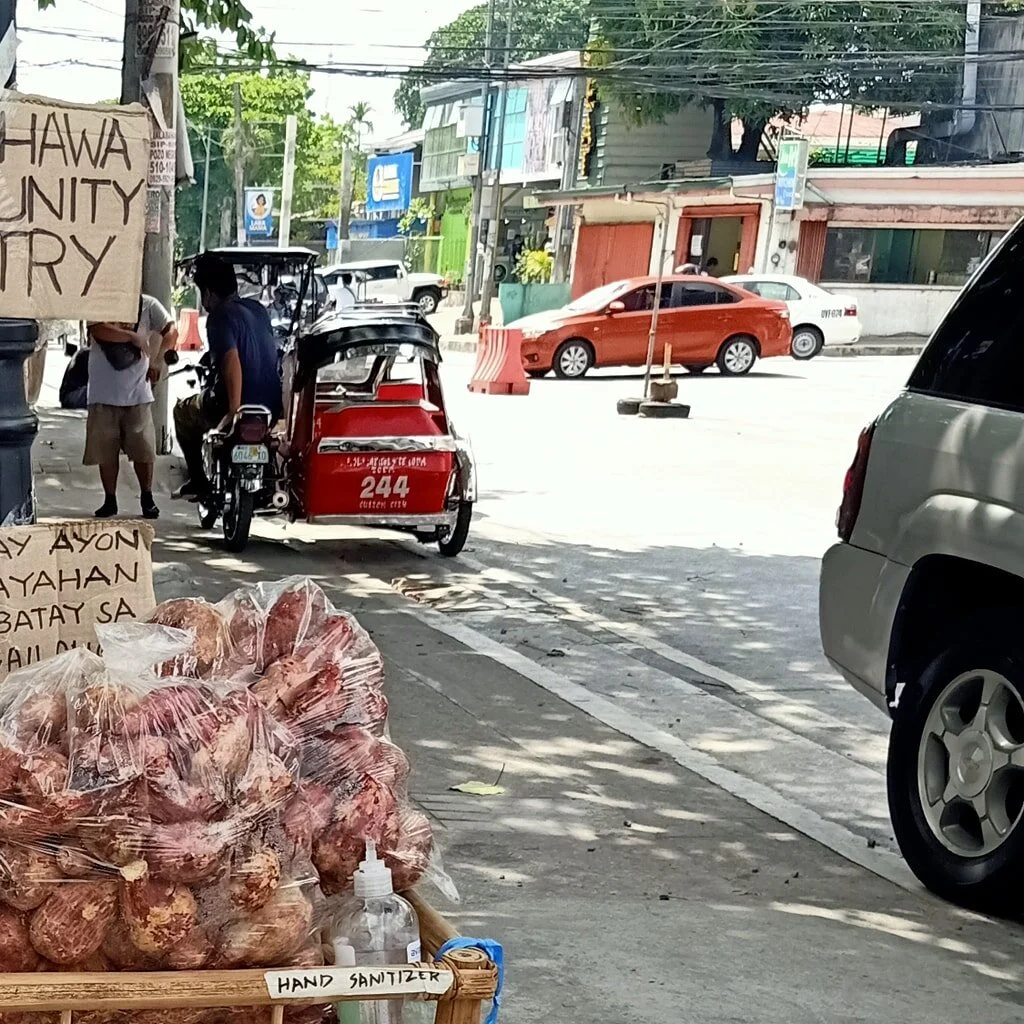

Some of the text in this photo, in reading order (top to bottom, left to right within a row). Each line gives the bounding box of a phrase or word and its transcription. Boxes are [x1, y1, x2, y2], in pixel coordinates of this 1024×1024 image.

[359, 475, 411, 499] 244
[48, 528, 139, 556] AYON
[96, 597, 137, 624] SA
[277, 969, 440, 994] HAND SANITIZER
